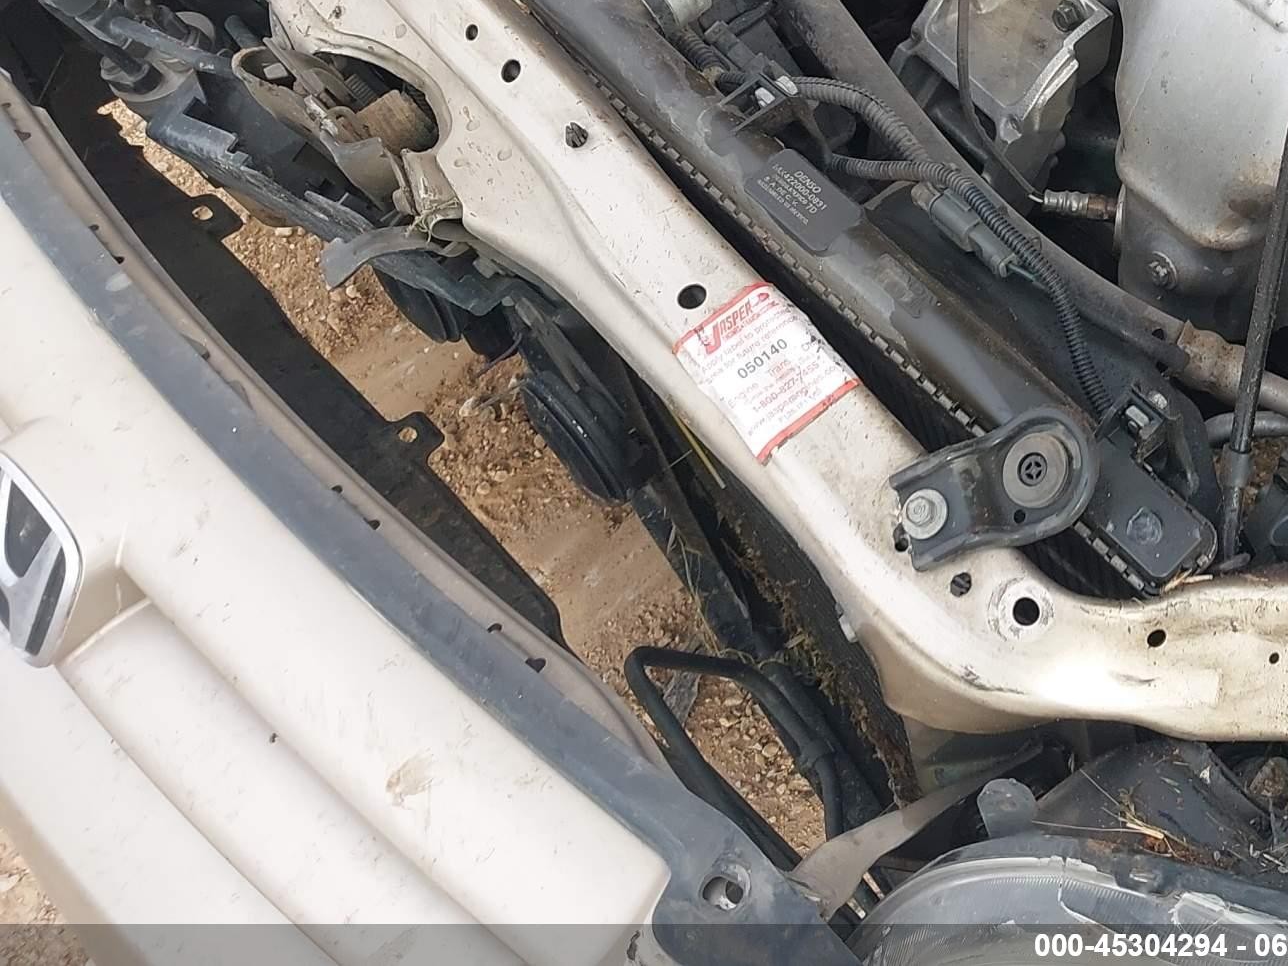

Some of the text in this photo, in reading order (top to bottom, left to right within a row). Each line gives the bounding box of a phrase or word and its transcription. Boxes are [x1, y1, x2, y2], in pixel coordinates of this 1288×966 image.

[794, 170, 822, 195] DENSO
[708, 299, 754, 355] JASPER
[737, 337, 789, 380] 050140
